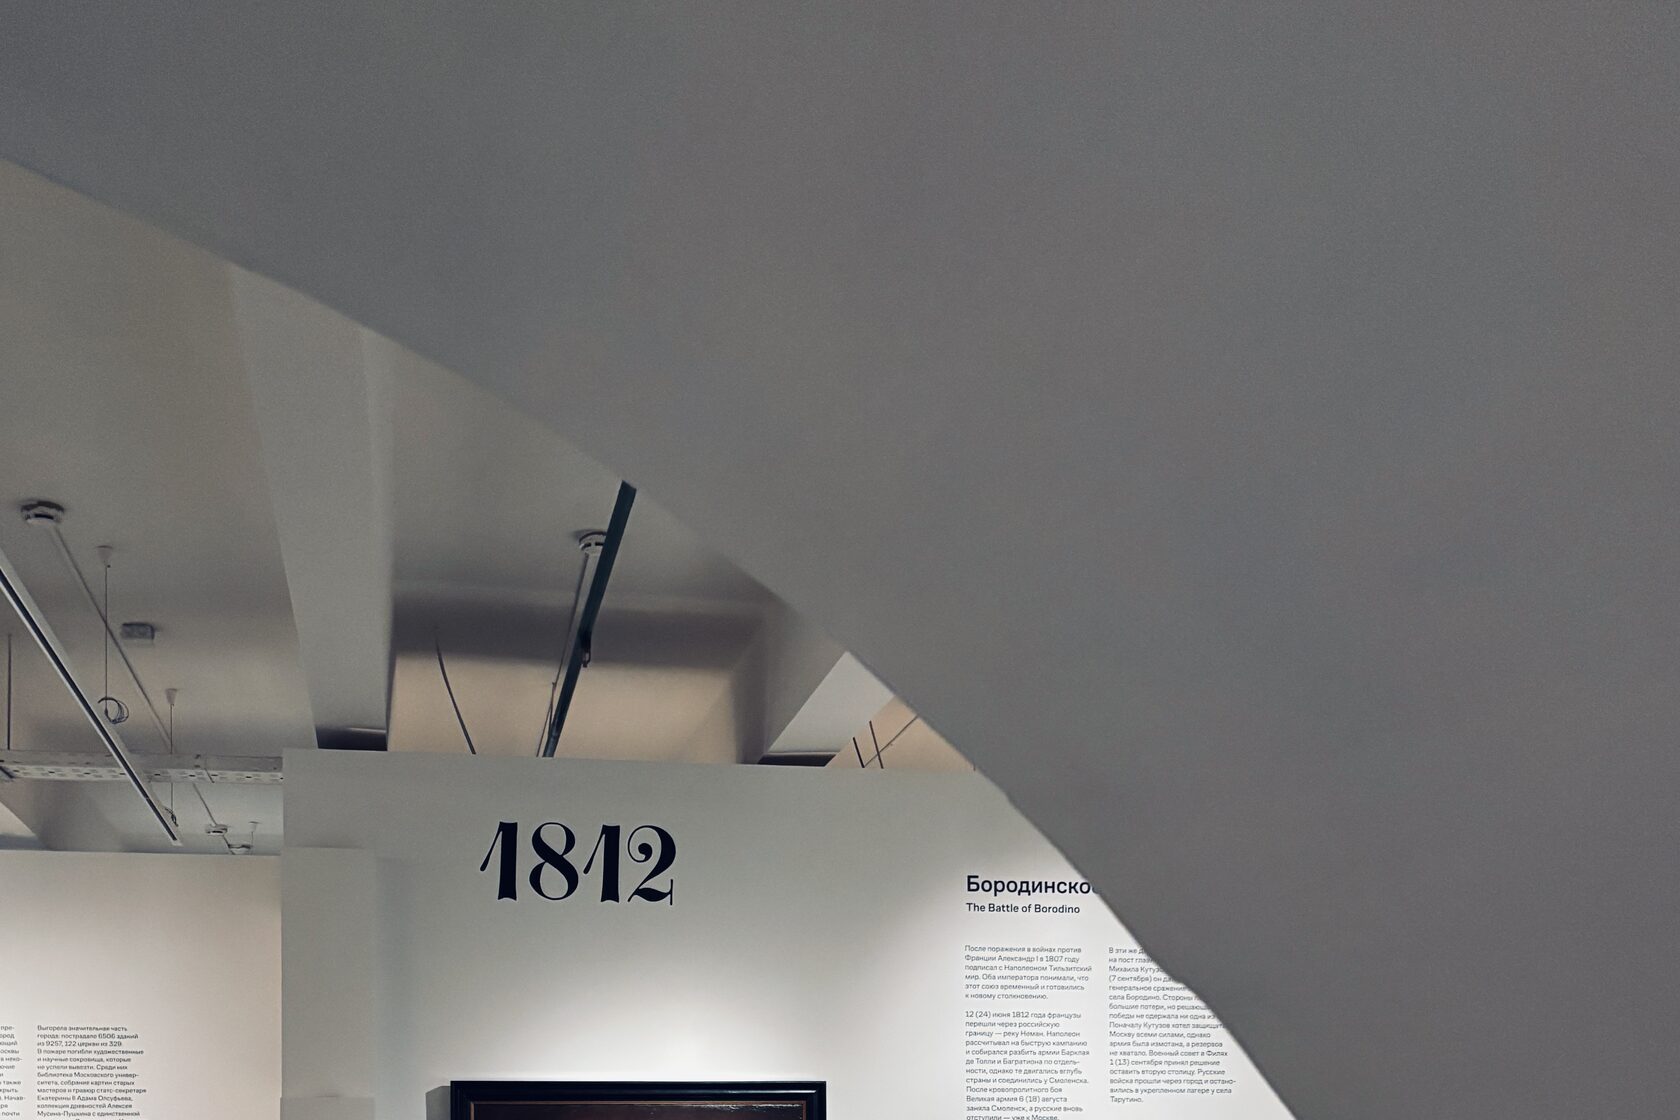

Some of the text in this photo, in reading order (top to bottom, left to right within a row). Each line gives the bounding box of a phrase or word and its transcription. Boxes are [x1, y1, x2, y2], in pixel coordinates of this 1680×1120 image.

[480, 821, 676, 905] 1812
[966, 903, 1080, 914] The Battle of Borodino
[964, 954, 996, 963] Франции
[1108, 965, 1139, 973] Михаила
[1162, 994, 1193, 1002] Стороны
[1046, 1011, 1081, 1020] французы
[1109, 1012, 1134, 1021] победы
[1109, 1021, 1142, 1030] Поначалу
[1142, 1021, 1170, 1030] Кутузов
[1109, 1031, 1135, 1039] Москву
[1020, 1039, 1051, 1048] быструю
[1109, 1041, 1131, 1049] армия
[1008, 1048, 1036, 1057] разбить
[1060, 1049, 1090, 1057] Барклая
[1130, 1058, 1162, 1067] сентября
[1059, 1067, 1082, 1076] вглубь
[1197, 1068, 1226, 1076] Русские
